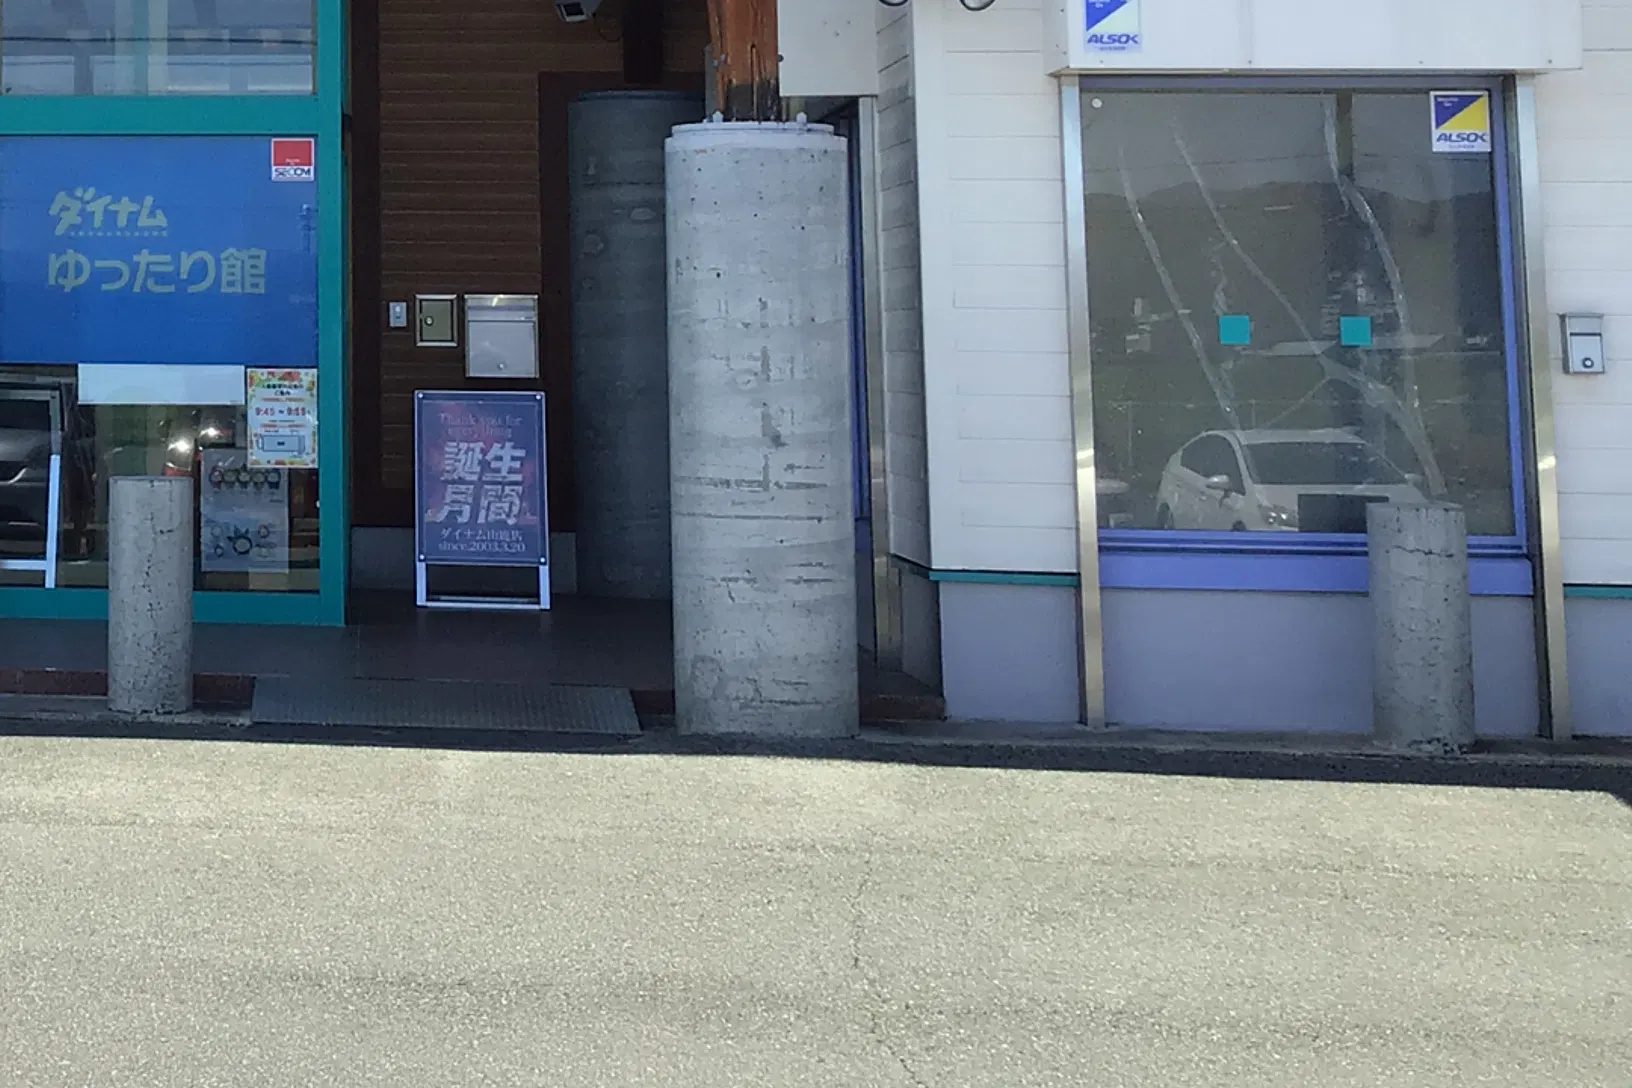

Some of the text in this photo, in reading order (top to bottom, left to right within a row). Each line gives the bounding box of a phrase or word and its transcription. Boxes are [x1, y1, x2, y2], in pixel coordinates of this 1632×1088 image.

[1087, 34, 1138, 44] ALSOK
[1436, 132, 1486, 143] ALSOK
[274, 166, 311, 177] SECOM
[48, 187, 168, 236] ダイナム
[47, 248, 267, 294] ゆったり館
[440, 441, 526, 481] 誕生
[425, 484, 523, 525] 月間
